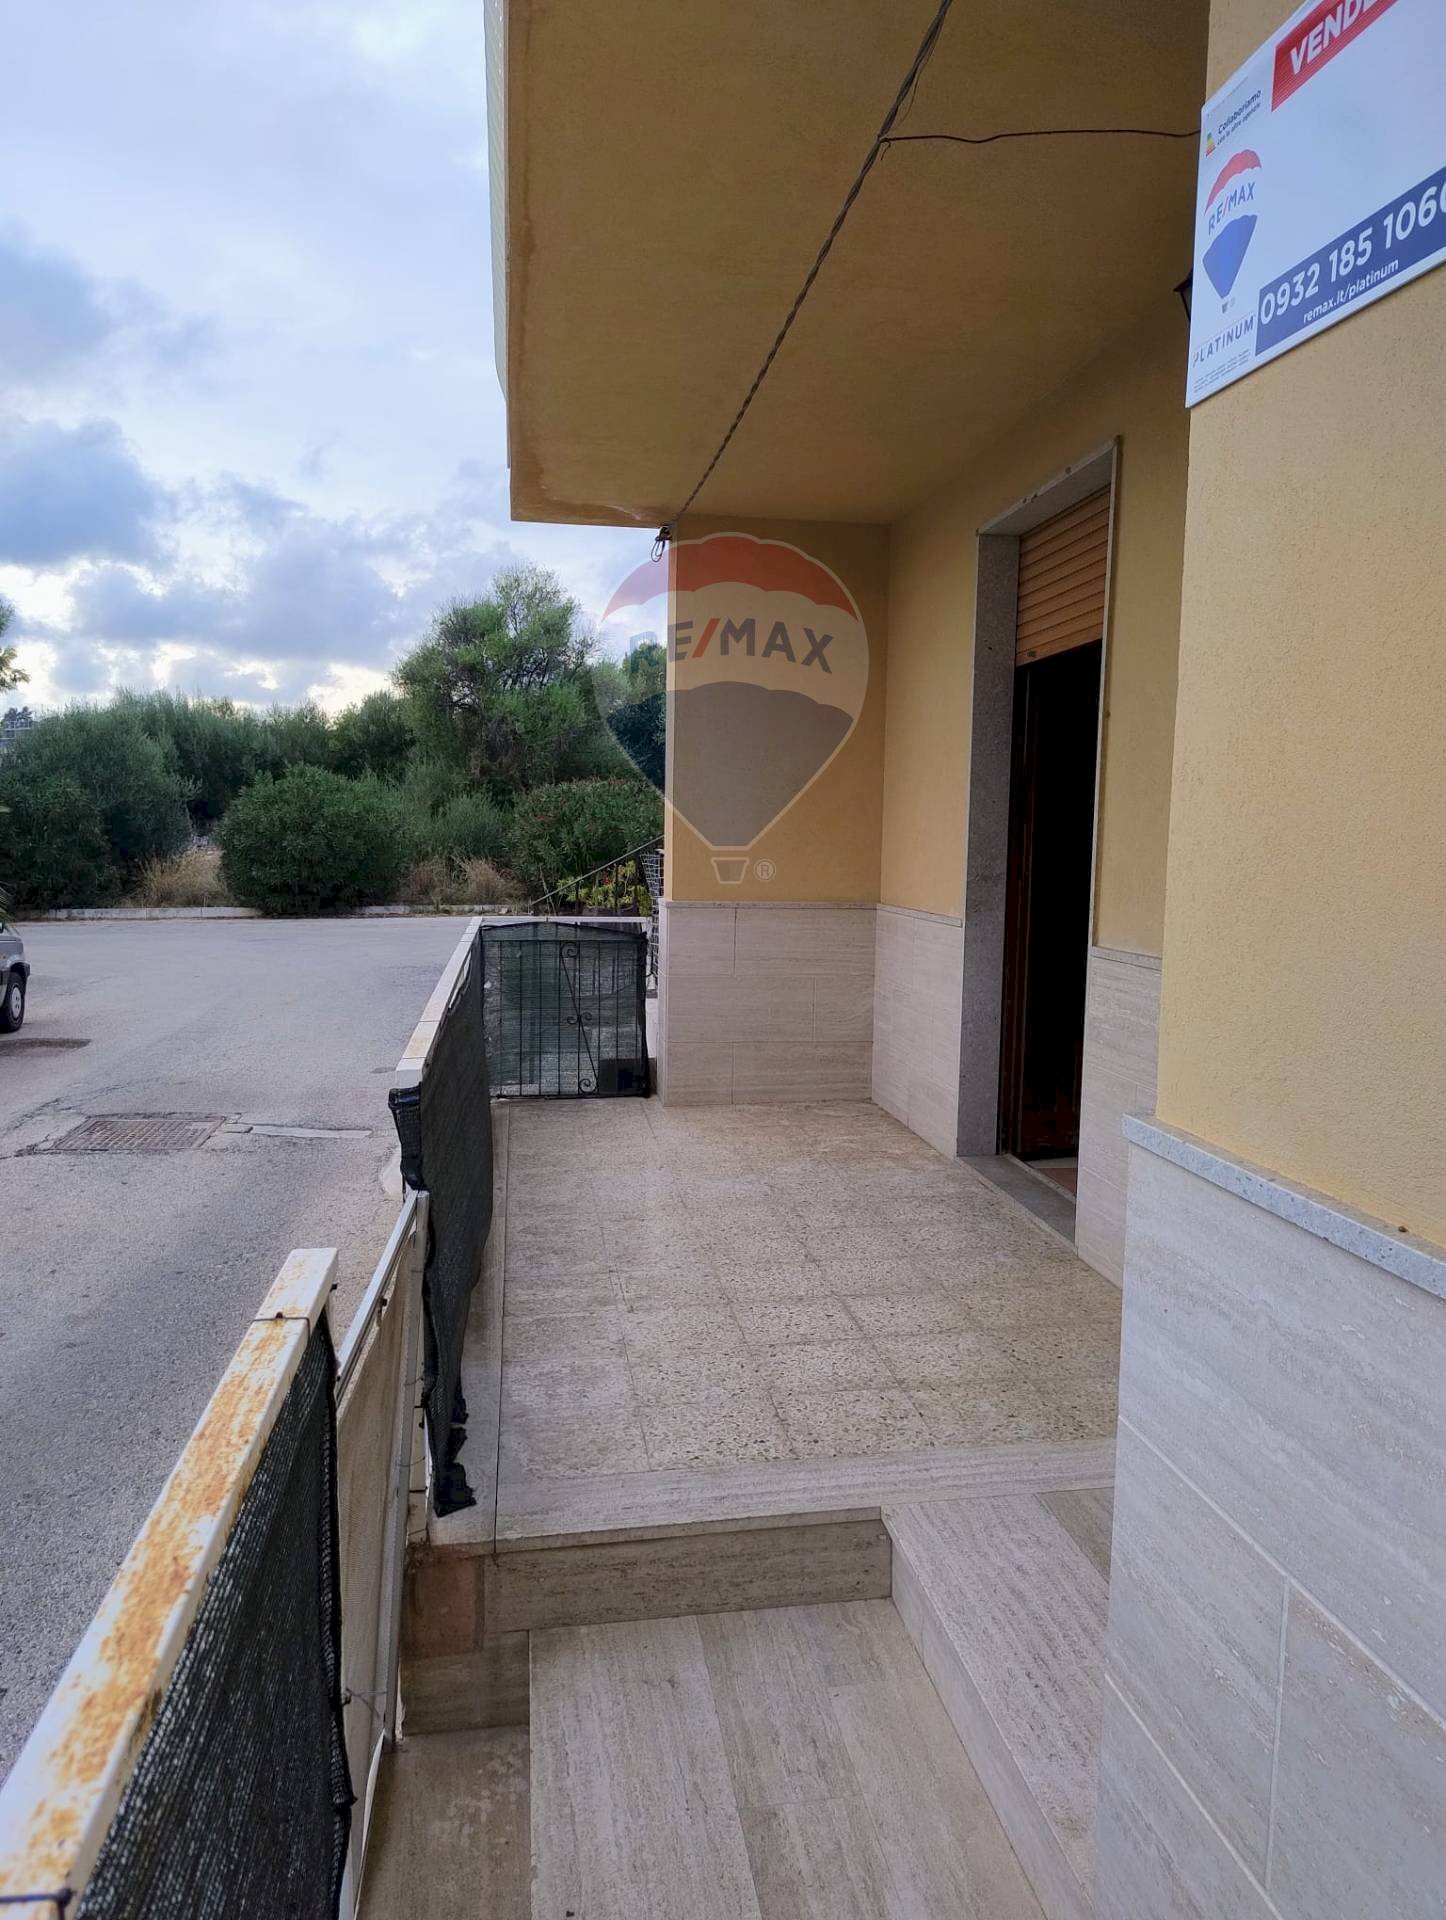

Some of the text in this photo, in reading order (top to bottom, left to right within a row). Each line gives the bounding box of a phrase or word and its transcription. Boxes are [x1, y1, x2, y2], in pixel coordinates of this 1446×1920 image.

[1218, 90, 1261, 134] Collaboriamo
[1208, 181, 1256, 236] RE/MAX
[1260, 262, 1321, 325] 0932
[1328, 227, 1373, 283] 185
[1303, 259, 1399, 324] remax.it/platinum
[1192, 315, 1254, 368] PLATINUM
